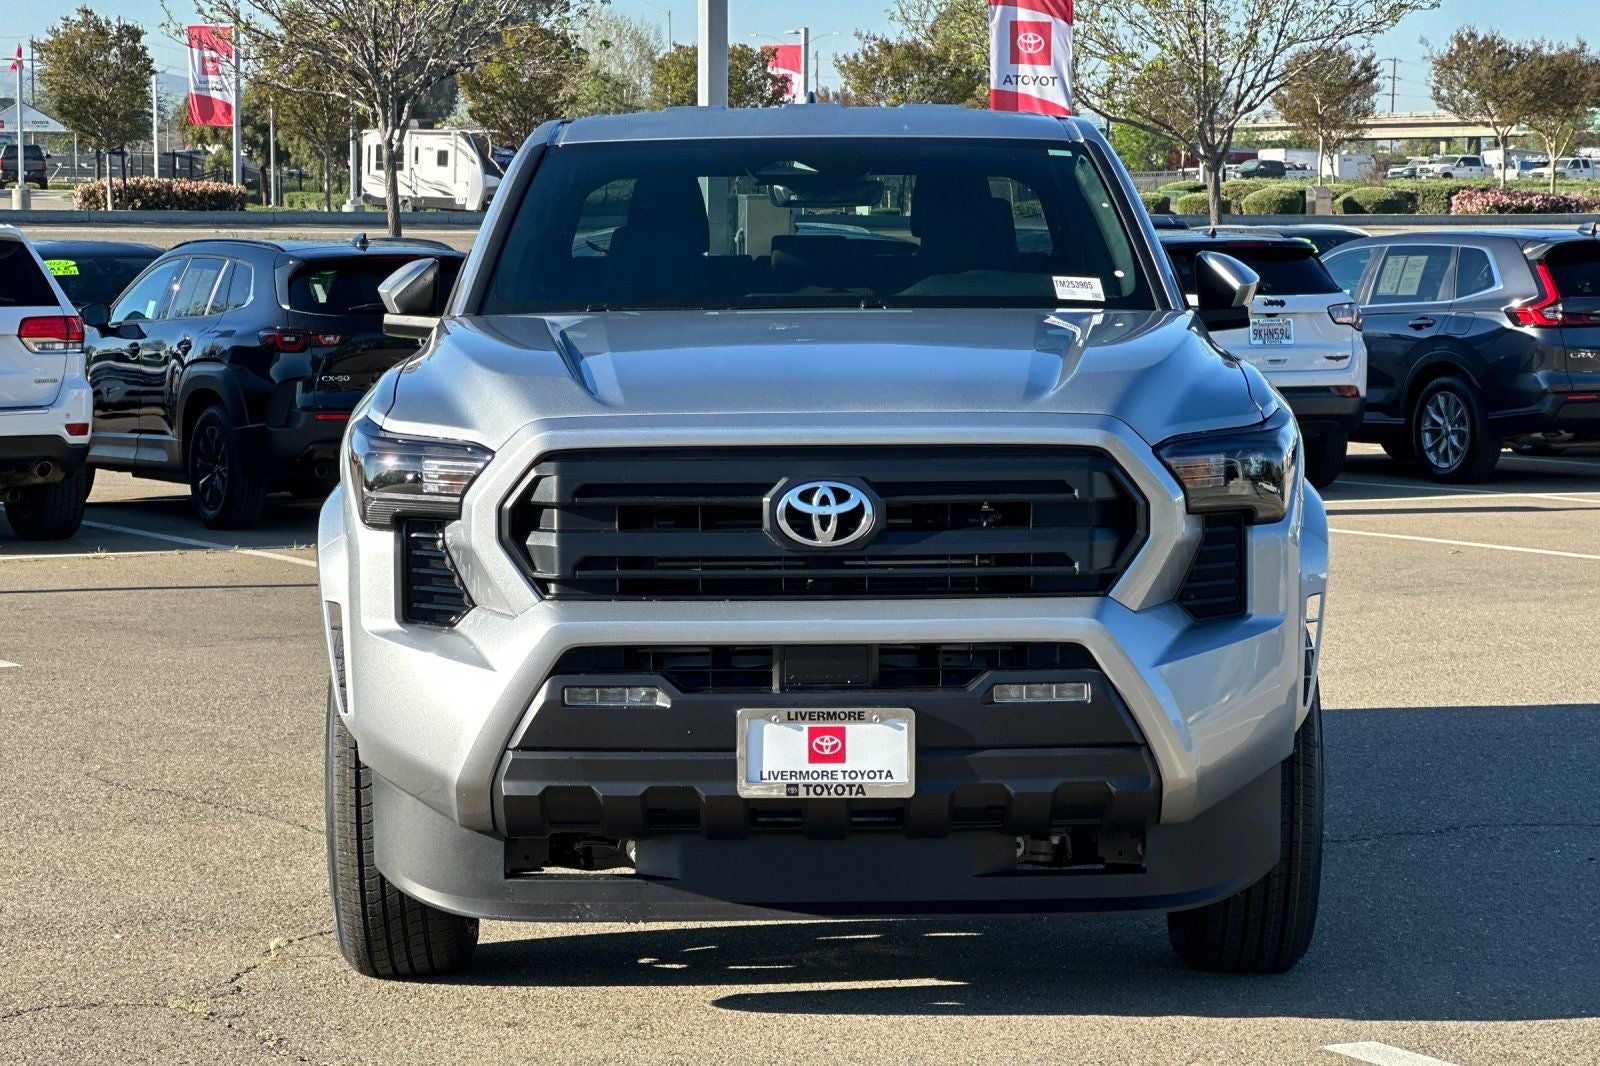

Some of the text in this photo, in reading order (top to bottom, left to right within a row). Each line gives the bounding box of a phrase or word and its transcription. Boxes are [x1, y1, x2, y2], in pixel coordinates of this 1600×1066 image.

[1055, 279, 1094, 291] TM253905
[1263, 297, 1286, 308] Jeep
[1253, 328, 1290, 341] 9KHN594
[787, 710, 866, 722] LIVERMORE
[760, 769, 894, 781] LIVERMORE TOYOTA
[803, 783, 866, 797] TOYOTA
